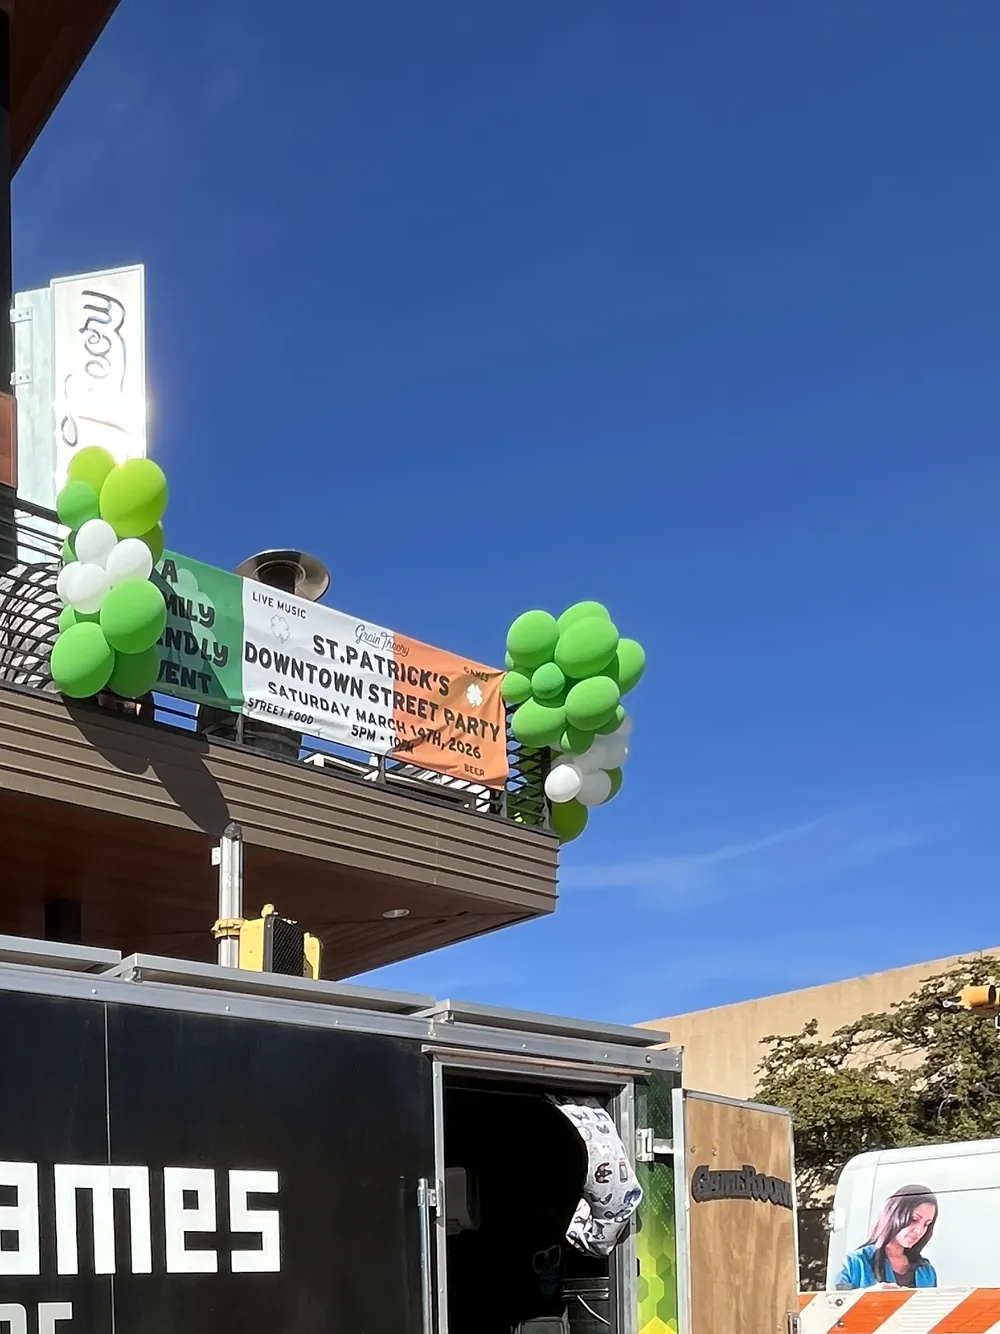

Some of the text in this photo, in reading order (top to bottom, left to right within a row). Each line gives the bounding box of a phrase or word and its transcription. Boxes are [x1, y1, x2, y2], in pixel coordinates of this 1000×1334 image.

[162, 559, 178, 583] A
[252, 592, 307, 619] LIVE MUSIC
[355, 624, 411, 657] Grain Theory
[463, 666, 489, 683] GAMES
[244, 641, 500, 742] DOWNTOWN STREET PARTY
[247, 698, 314, 725] STREET FOOD
[268, 681, 350, 718] SATURDAY
[356, 708, 407, 734] MARCH
[449, 737, 481, 760] 2026
[351, 724, 376, 742] 5PM
[464, 763, 485, 777] BEER
